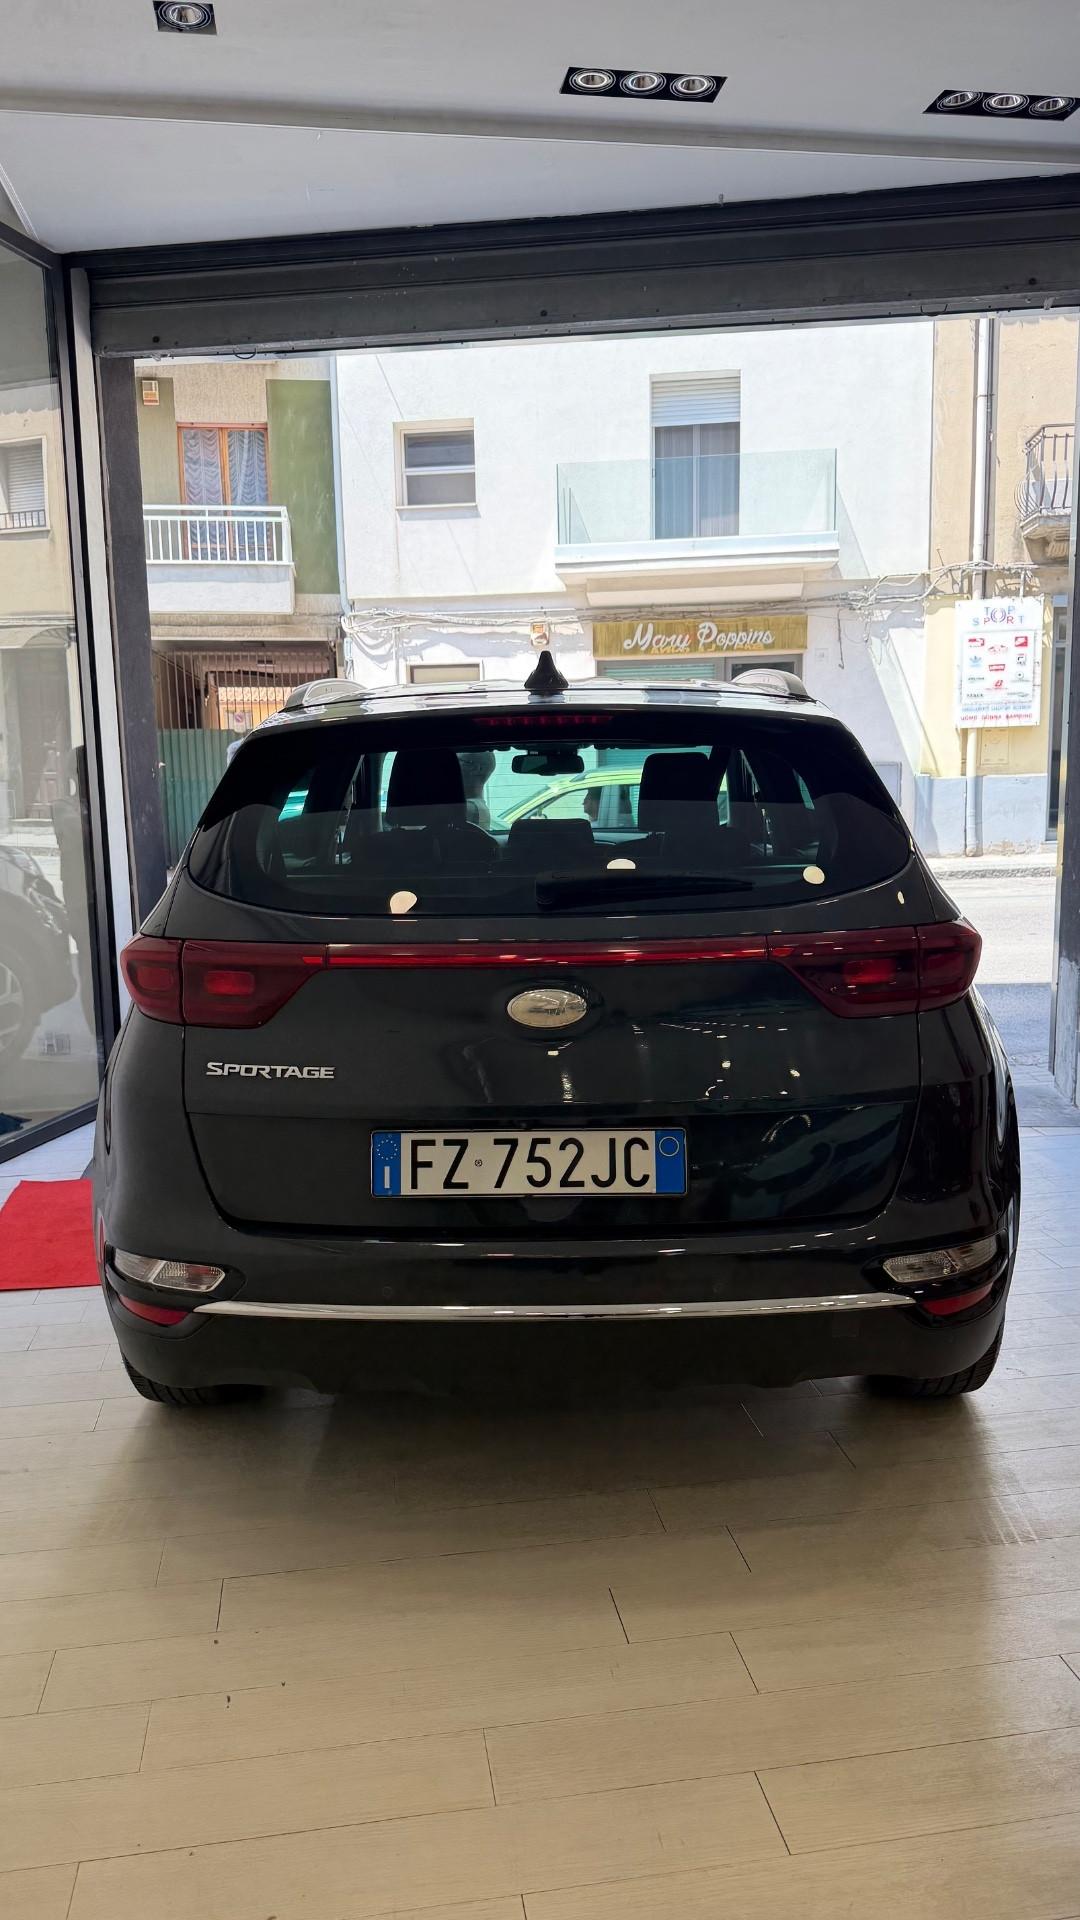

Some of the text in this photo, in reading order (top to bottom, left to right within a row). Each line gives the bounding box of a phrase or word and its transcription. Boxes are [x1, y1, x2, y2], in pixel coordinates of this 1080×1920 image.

[972, 613, 1025, 626] SPORT
[983, 605, 1016, 620] TOP
[623, 622, 691, 651] Mary
[697, 620, 775, 650] Poppins
[206, 1062, 336, 1079] SPORTAGE
[410, 1136, 650, 1190] FZ 752JC
